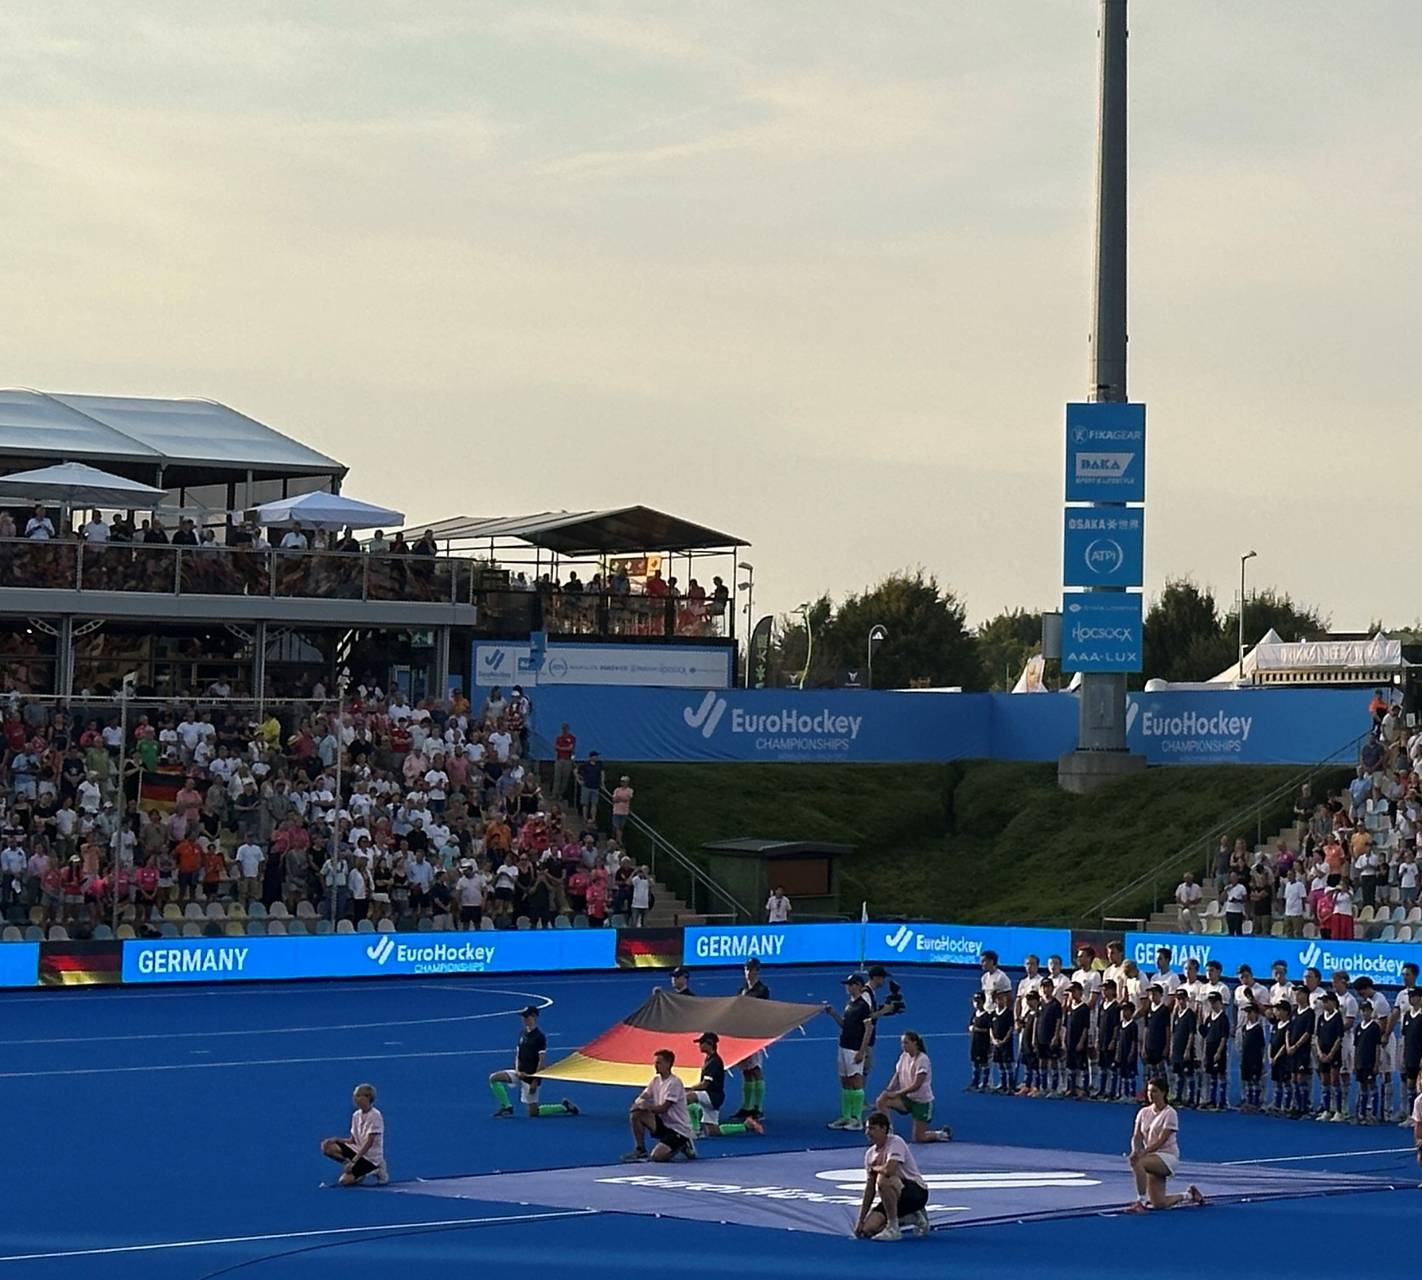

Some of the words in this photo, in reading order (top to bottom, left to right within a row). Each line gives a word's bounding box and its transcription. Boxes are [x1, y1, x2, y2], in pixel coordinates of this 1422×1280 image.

[1068, 519, 1106, 529] OSAKA
[732, 709, 862, 739] EuroHockey
[1142, 711, 1252, 740] EuroHockey
[755, 737, 849, 750] CHAMPIONSHIPS
[1161, 740, 1242, 752] CHAMPIONSHIPS
[397, 942, 496, 964] EuroHockey
[697, 934, 785, 957] GERMANY
[916, 934, 983, 957] EuroHockey
[138, 948, 249, 974] GERMANY
[1323, 952, 1405, 977] EuroHockey
